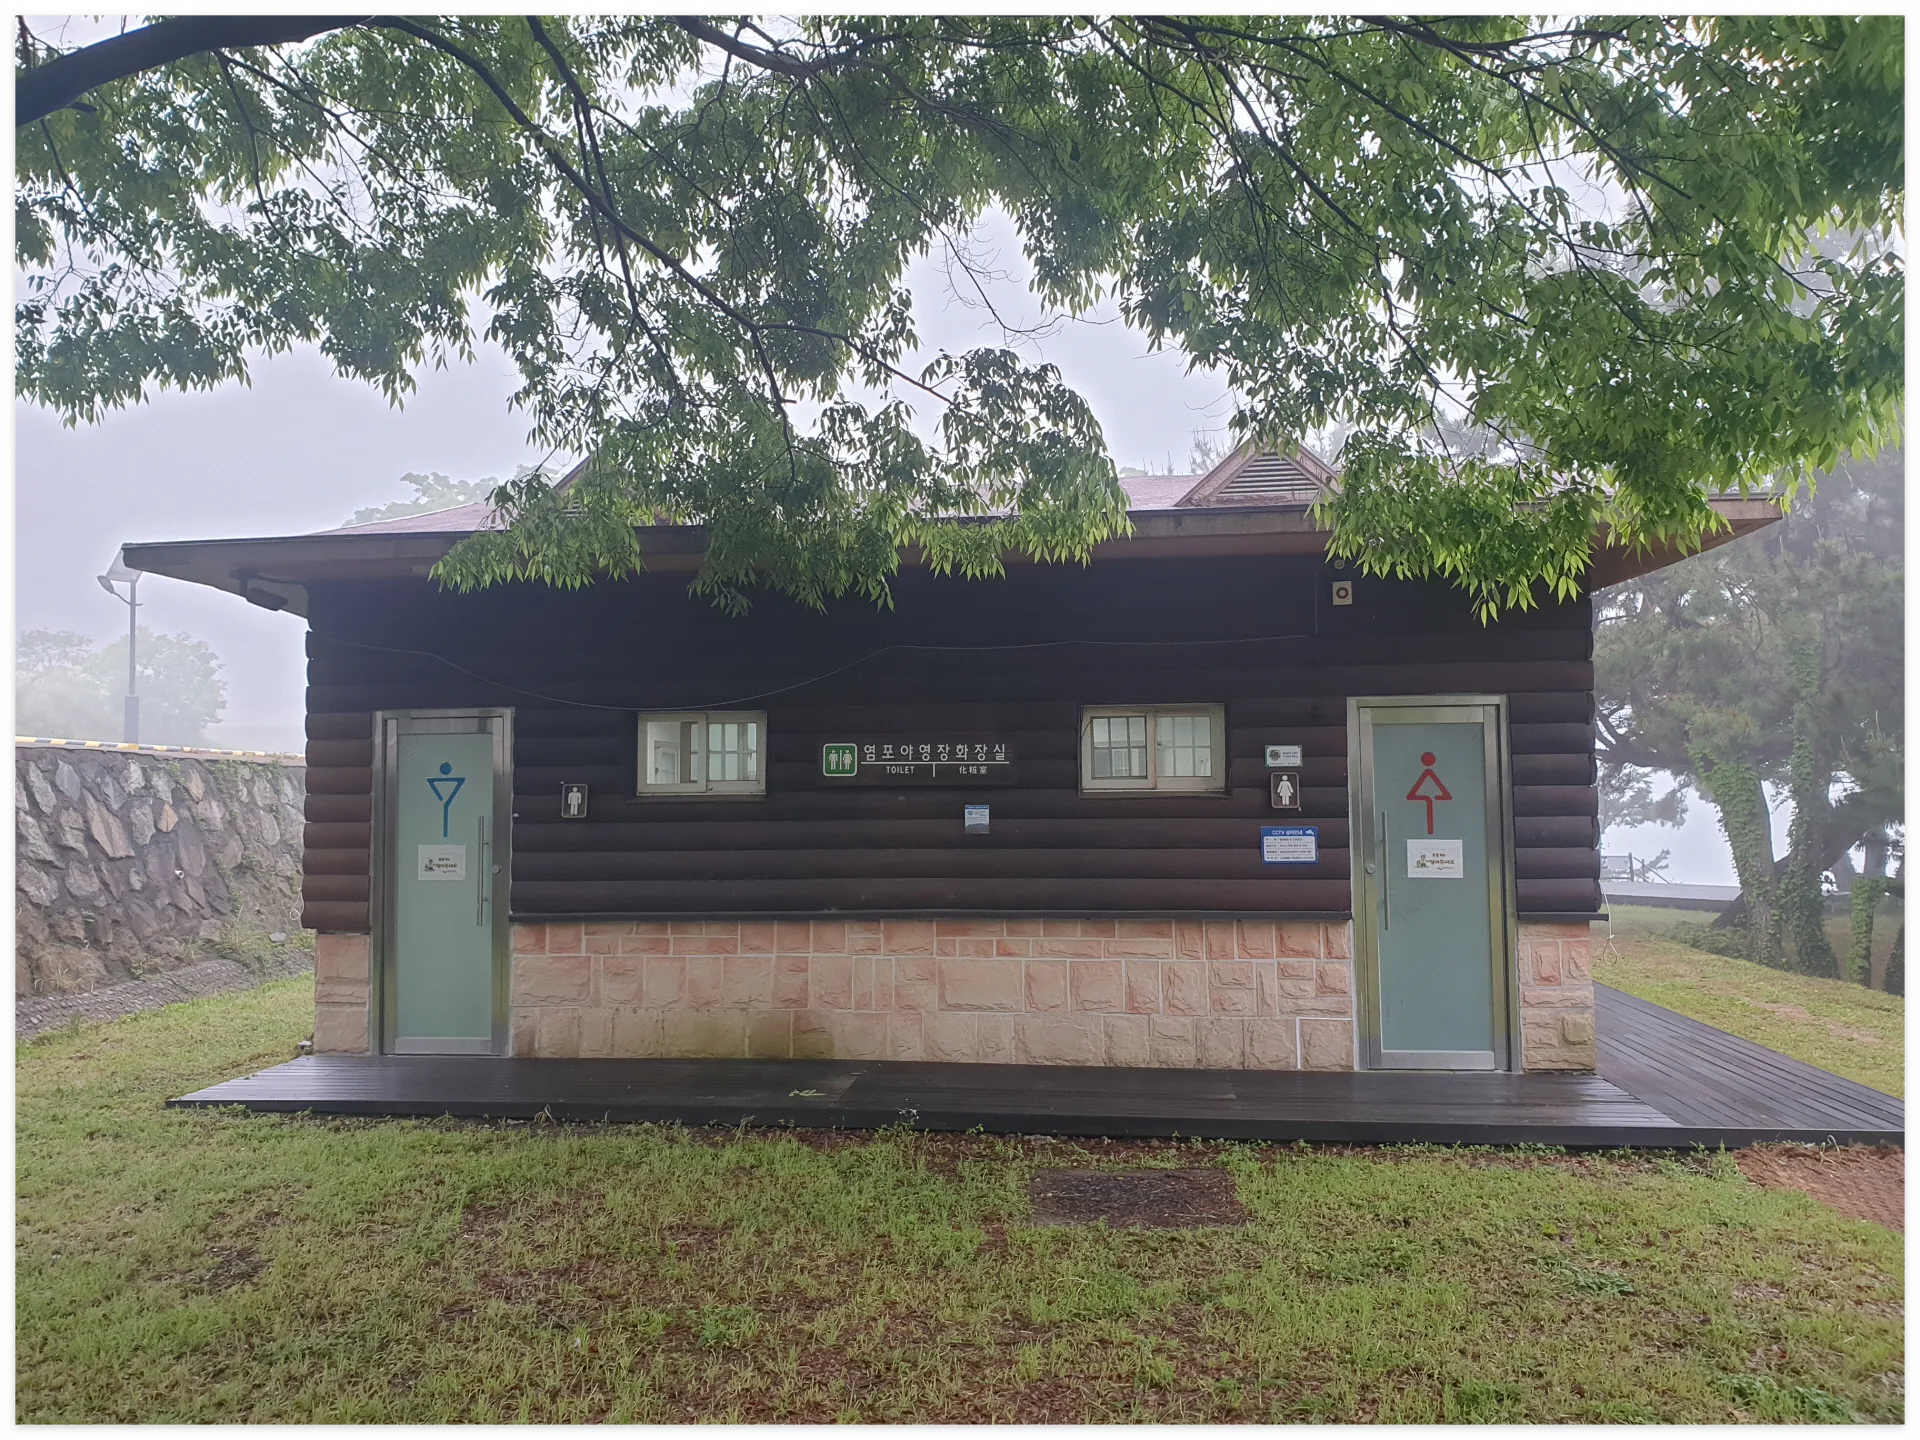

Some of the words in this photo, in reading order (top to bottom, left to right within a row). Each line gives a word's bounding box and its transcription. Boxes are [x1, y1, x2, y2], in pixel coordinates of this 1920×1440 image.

[864, 743, 1006, 762] 염포야영장화장실
[885, 766, 915, 774] TOILET
[958, 765, 988, 775] 化粧室
